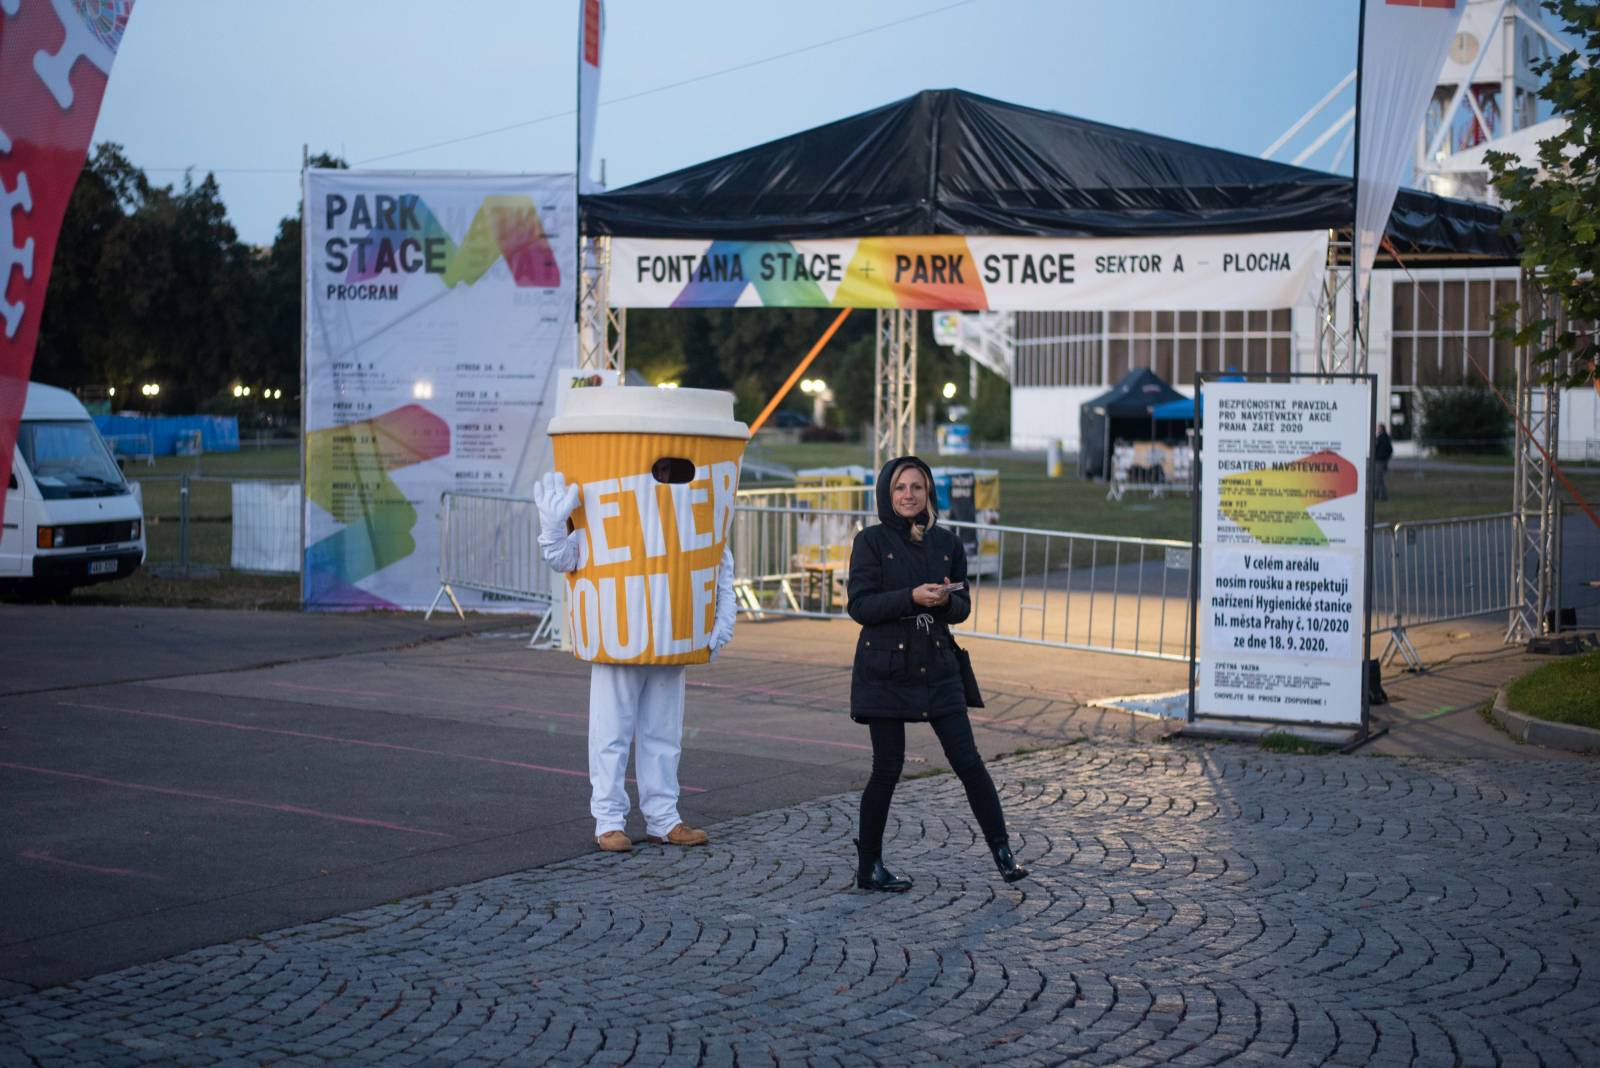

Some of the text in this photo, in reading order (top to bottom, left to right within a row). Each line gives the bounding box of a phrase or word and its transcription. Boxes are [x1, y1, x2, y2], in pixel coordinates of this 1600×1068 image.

[326, 194, 421, 230] PARK
[325, 238, 446, 274] STAGE
[637, 254, 743, 283] FONTANA
[760, 253, 843, 282] STAGE
[894, 254, 965, 284] PARK
[984, 254, 1075, 284] STAGE
[1095, 255, 1162, 273] SEKTOR
[1173, 255, 1184, 273] A
[1223, 252, 1291, 272] PLOCHA
[1292, 399, 1338, 410] PRAVIDLA
[1219, 422, 1246, 432] PRAHA
[1244, 555, 1252, 570] V
[1285, 557, 1319, 572] areálu
[1249, 575, 1284, 590] roušku
[1286, 581, 1292, 590] a
[1295, 577, 1348, 595] respektuji
[1256, 597, 1312, 613] Hygienické
[1315, 600, 1352, 613] stanice
[1214, 614, 1228, 627] hl.
[1264, 617, 1294, 633] Prahy
[1308, 618, 1349, 633] 10/2020
[1234, 635, 1328, 652] ze dne 18. 9. 2020.
